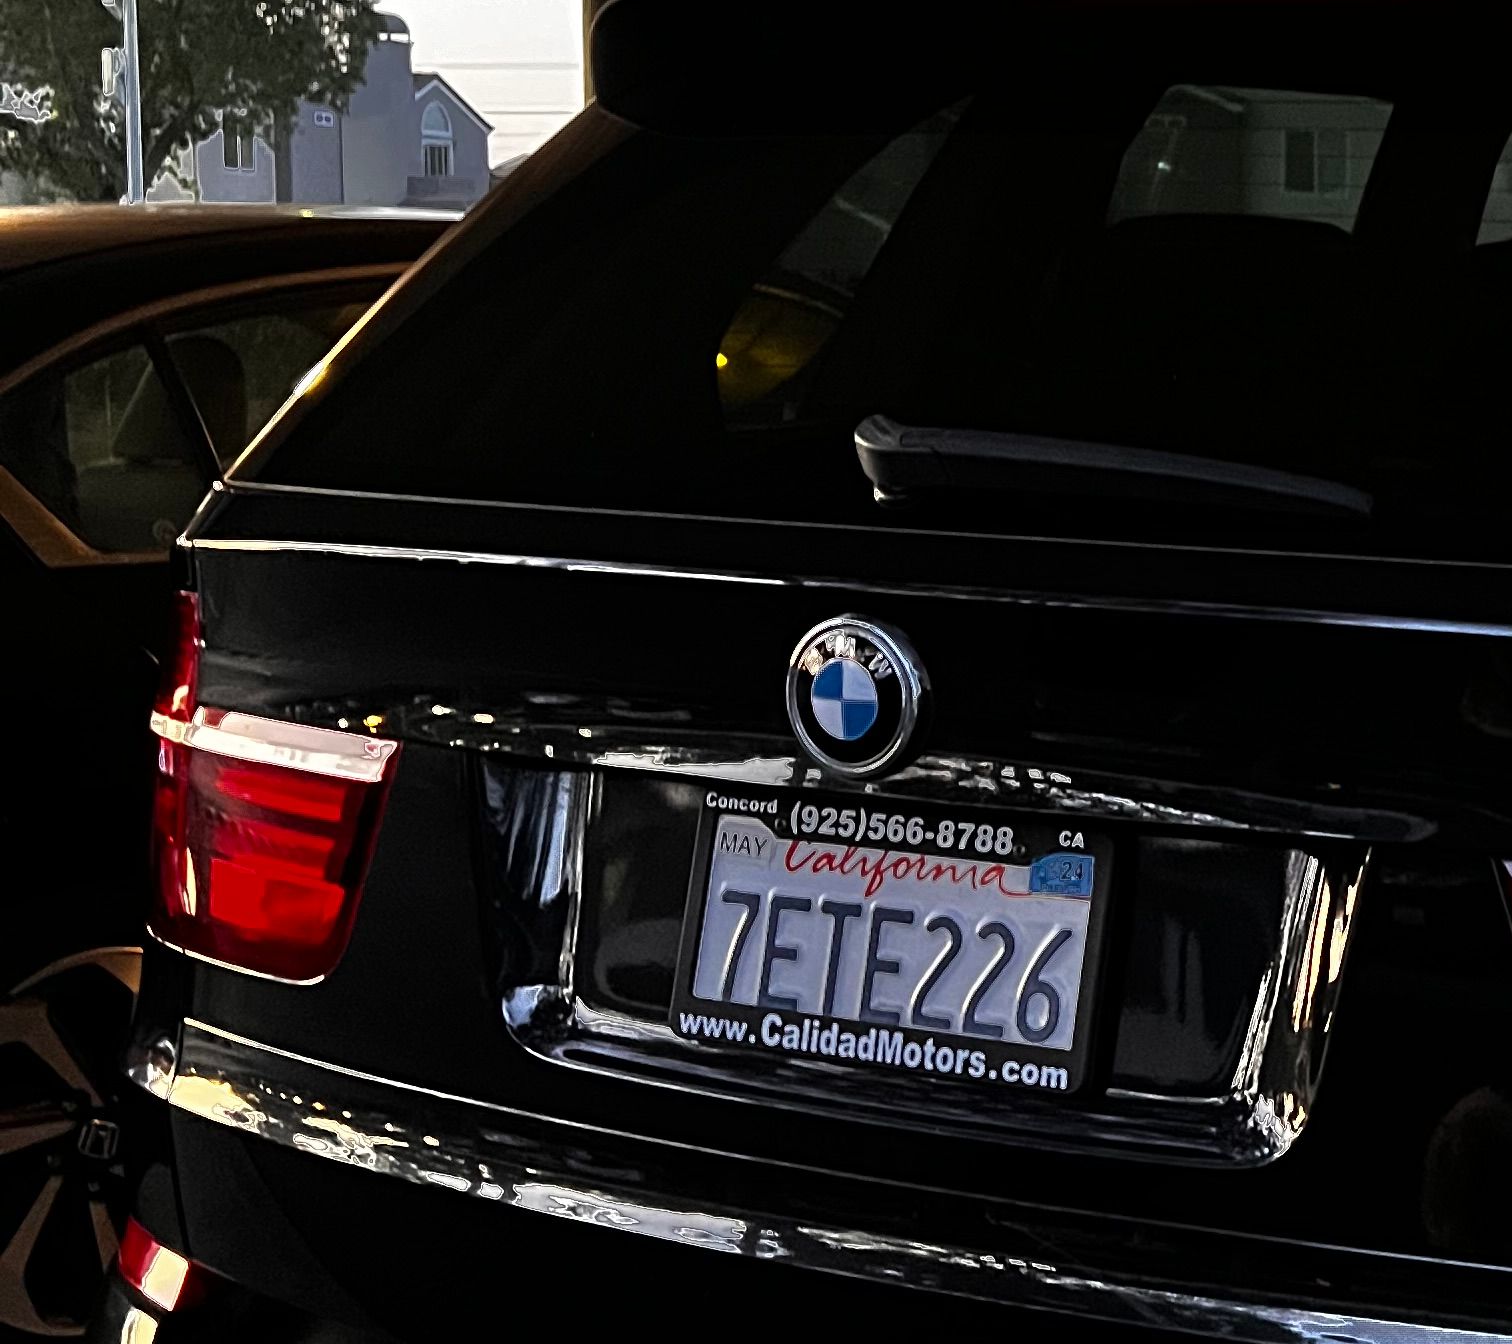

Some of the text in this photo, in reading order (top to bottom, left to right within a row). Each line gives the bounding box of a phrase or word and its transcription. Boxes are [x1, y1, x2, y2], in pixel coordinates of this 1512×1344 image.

[705, 791, 779, 814] Concord
[790, 800, 1014, 855] (925)566-8788
[720, 831, 768, 857] MAY
[1058, 830, 1085, 849] CA
[783, 839, 1035, 897] California
[719, 888, 1074, 1044] 7ETE226
[679, 1010, 1069, 1090] www.CalidadMotors.com
